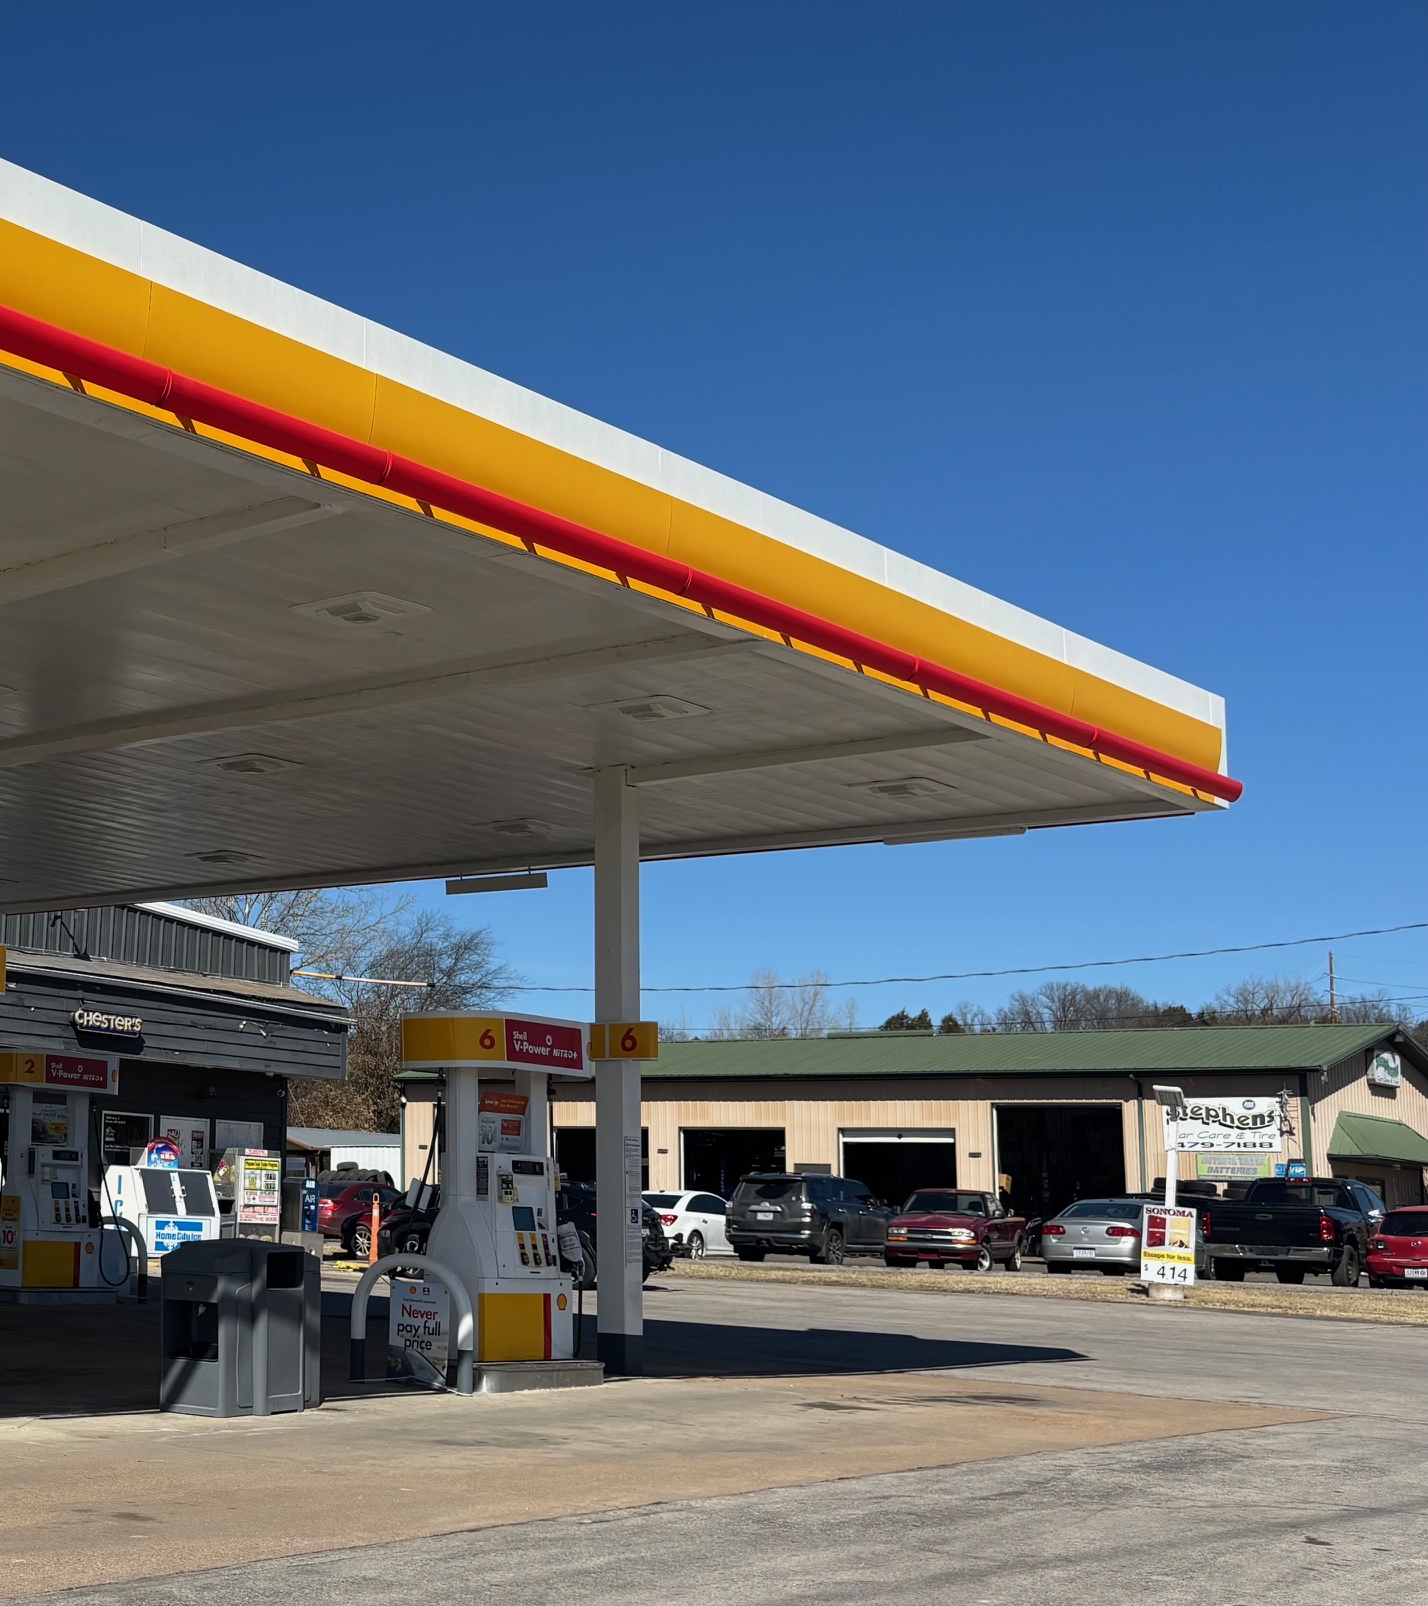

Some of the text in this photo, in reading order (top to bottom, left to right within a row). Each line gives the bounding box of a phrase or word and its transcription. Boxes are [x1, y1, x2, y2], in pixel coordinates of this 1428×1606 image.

[479, 1028, 495, 1050] 6
[513, 1030, 527, 1041] Shell
[620, 1027, 638, 1052] 6
[513, 1040, 550, 1056] V-Power
[23, 1059, 35, 1074] 2
[1197, 1131, 1231, 1140] Care
[1236, 1131, 1245, 1140] &
[1250, 1131, 1276, 1140] Tire
[1207, 1166, 1258, 1175] BATTERIES
[305, 1180, 316, 1189] AIR
[304, 1194, 316, 1203] AIR
[1145, 1206, 1194, 1218] SONOMA
[155, 1231, 202, 1241] Home City Ice
[1143, 1251, 1165, 1259] Escape
[1143, 1263, 1149, 1272] $
[401, 1303, 438, 1321] Never
[397, 1320, 441, 1338] pay full
[404, 1335, 432, 1352] price
